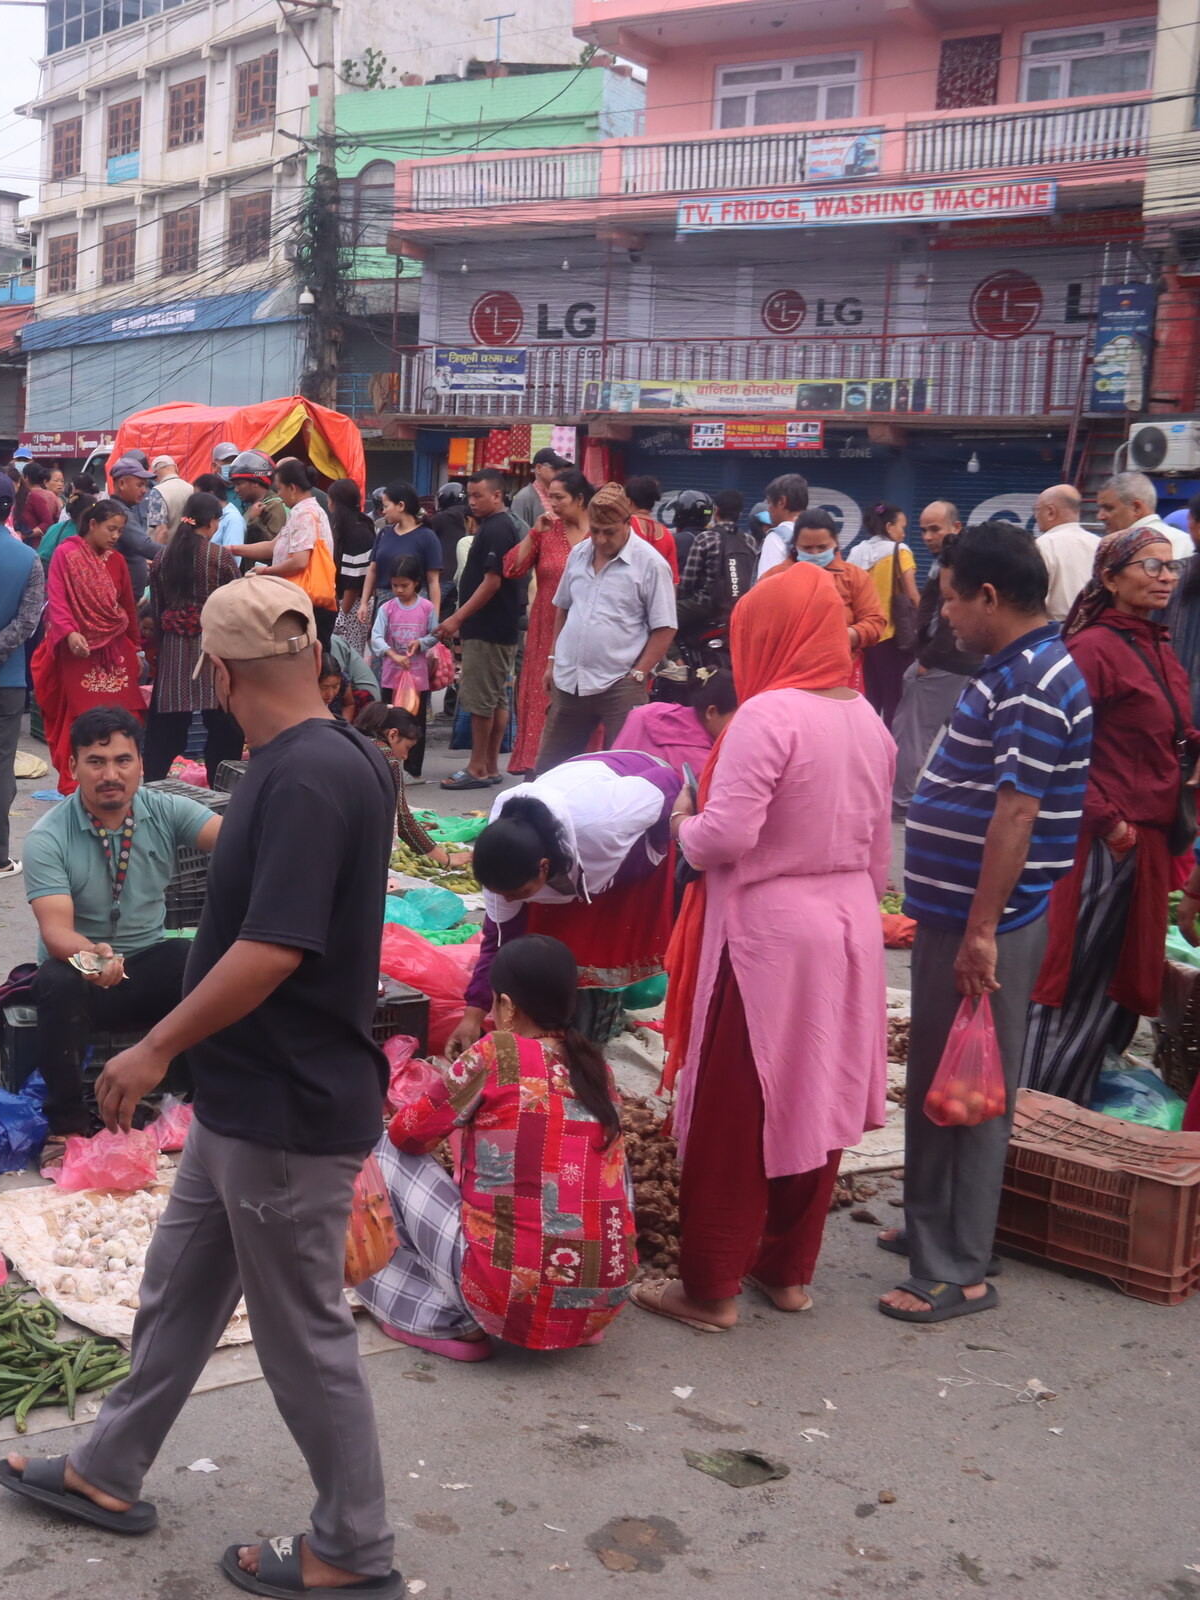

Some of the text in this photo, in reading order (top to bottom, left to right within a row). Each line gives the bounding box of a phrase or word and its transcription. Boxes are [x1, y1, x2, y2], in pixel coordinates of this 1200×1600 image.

[681, 183, 1050, 225] TV, FRIDGE, WASHING MACHINE
[536, 302, 597, 339] LG
[815, 297, 863, 326] LG
[1064, 283, 1098, 323] L
[778, 448, 829, 458] MOBILE
[838, 447, 872, 458] ZONE
[728, 558, 740, 598] Reebok
